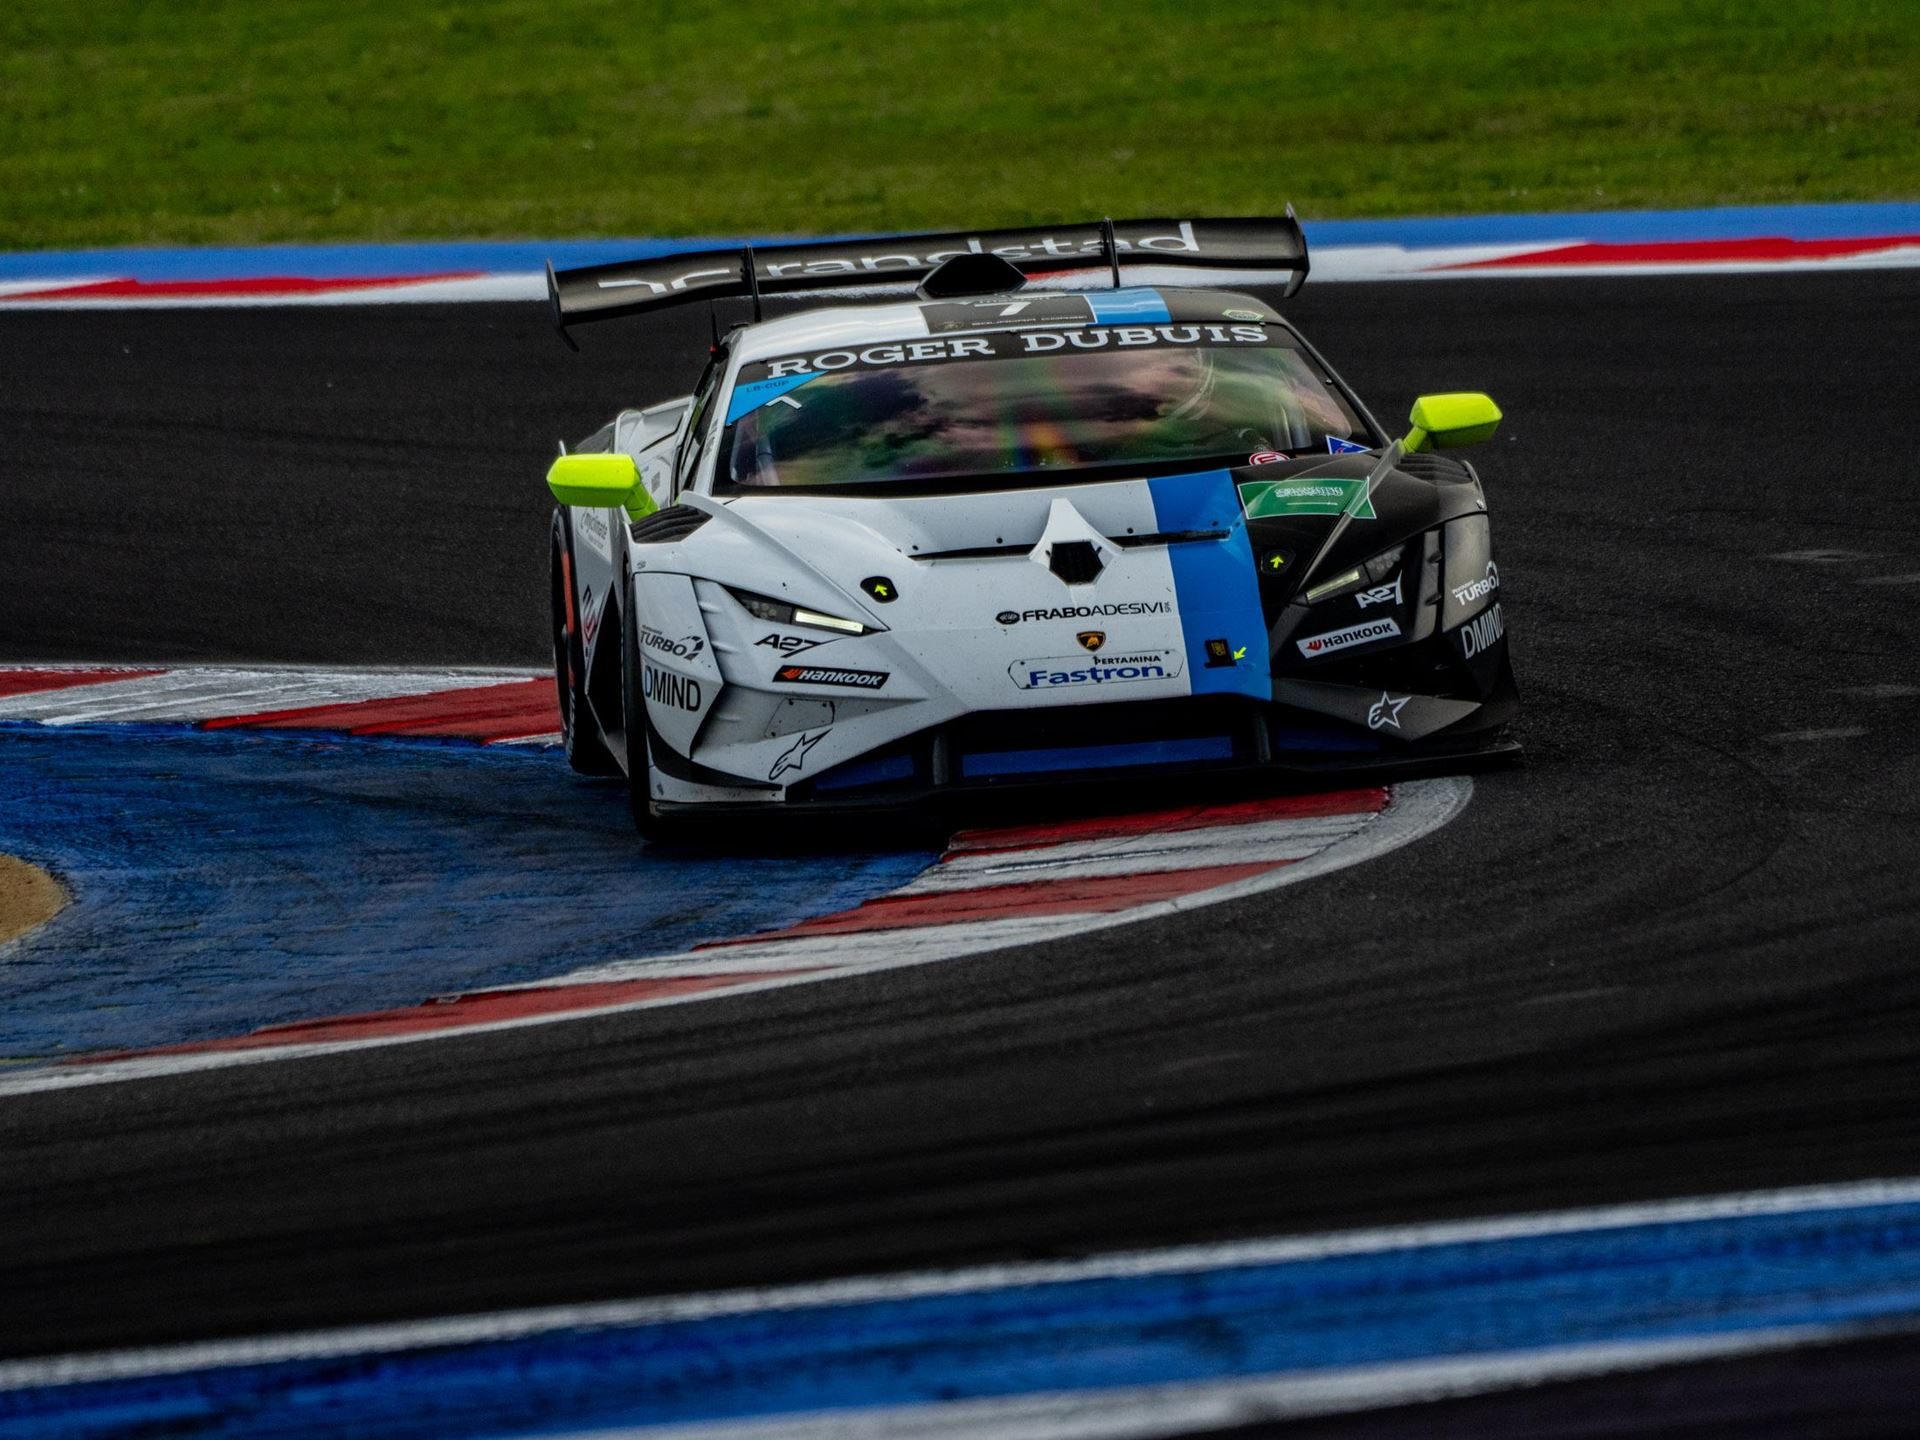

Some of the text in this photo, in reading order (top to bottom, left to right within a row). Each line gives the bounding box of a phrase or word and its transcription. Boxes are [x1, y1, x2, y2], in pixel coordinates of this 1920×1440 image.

[767, 325, 1268, 380] ROGER DUBUIS
[1460, 602, 1504, 660] DMIND
[1029, 665, 1164, 686] Fastron
[1093, 655, 1161, 665] PERTAMINA
[644, 664, 702, 712] DMIND
